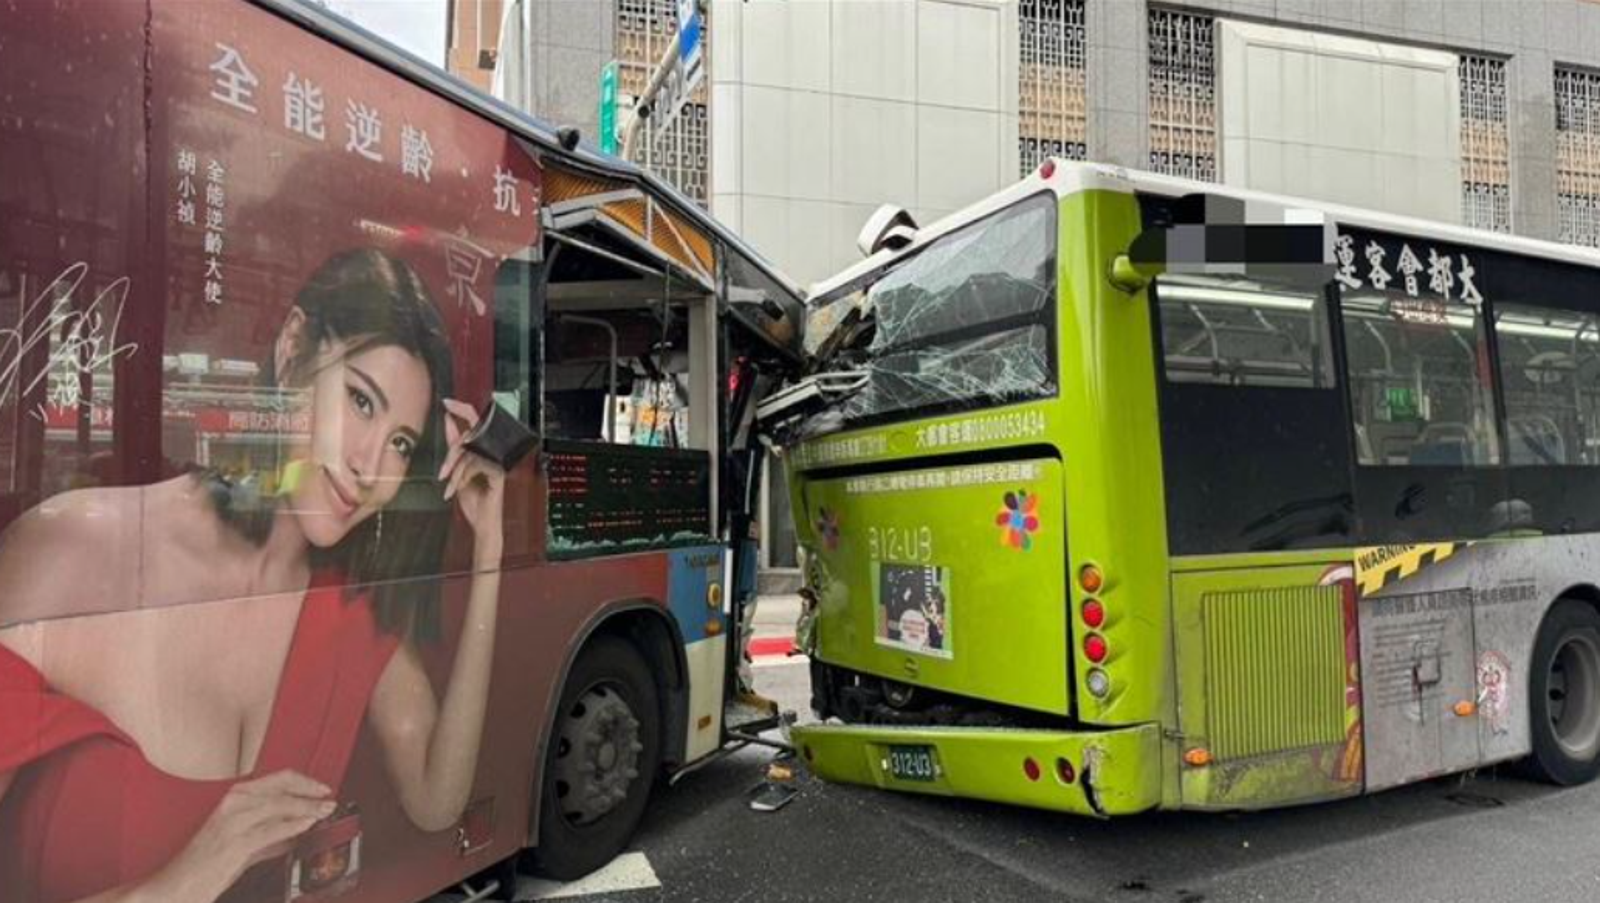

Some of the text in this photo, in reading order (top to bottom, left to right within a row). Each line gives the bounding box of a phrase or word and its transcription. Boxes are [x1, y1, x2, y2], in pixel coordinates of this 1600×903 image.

[204, 160, 226, 305] 全能逆齡大使
[891, 752, 931, 776] 312-U3
